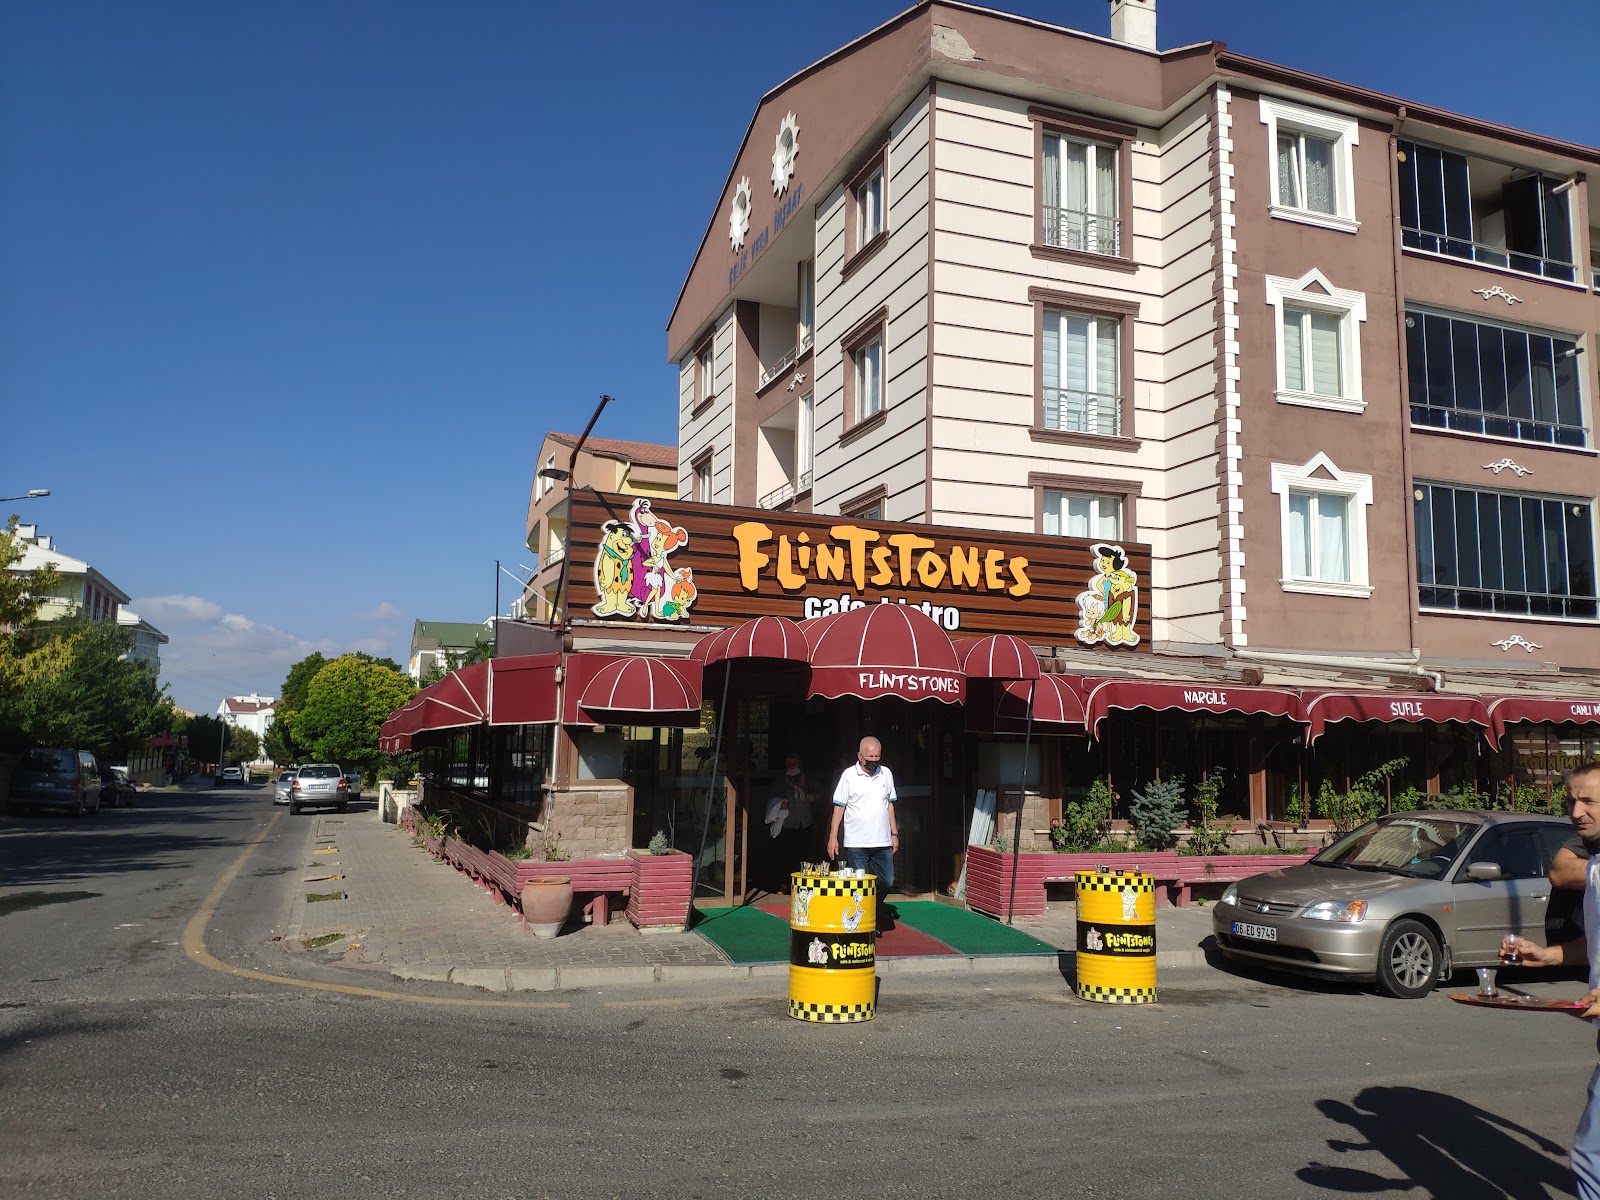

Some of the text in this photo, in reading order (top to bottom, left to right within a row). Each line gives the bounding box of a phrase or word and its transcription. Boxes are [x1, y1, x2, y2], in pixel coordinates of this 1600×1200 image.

[1390, 701, 1425, 716] SUFLE
[1570, 704, 1592, 716] CANLI
[1235, 923, 1244, 935] 06
[1256, 926, 1275, 939] 9749
